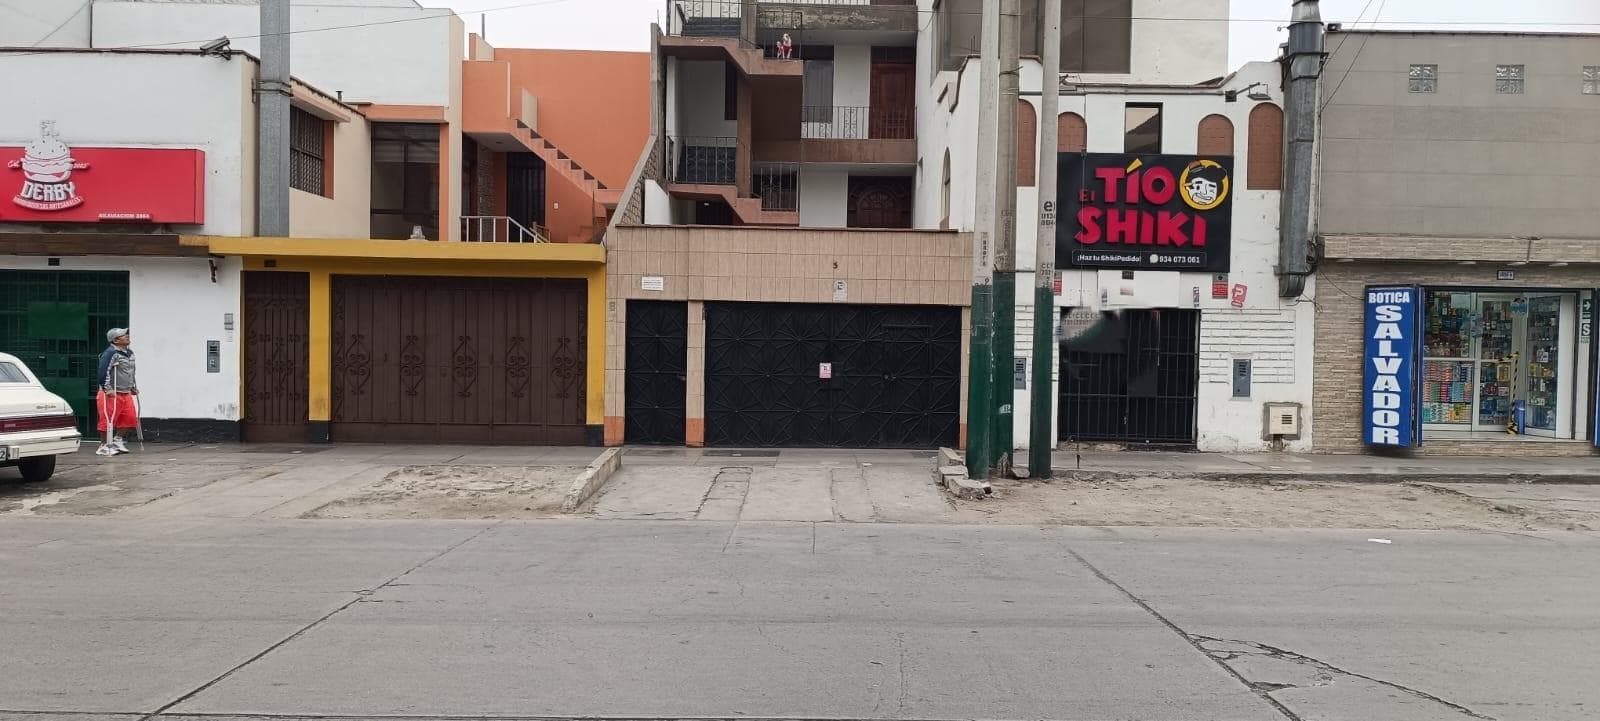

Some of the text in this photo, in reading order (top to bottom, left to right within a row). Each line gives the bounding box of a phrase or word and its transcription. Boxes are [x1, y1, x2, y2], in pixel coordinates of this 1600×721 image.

[20, 180, 76, 202] DERBY
[1095, 158, 1176, 204] TÍO
[1074, 206, 1207, 248] SHIKI
[1160, 255, 1172, 263] 934
[1368, 292, 1411, 304] BOTICA
[1372, 305, 1404, 445] SALVADOR
